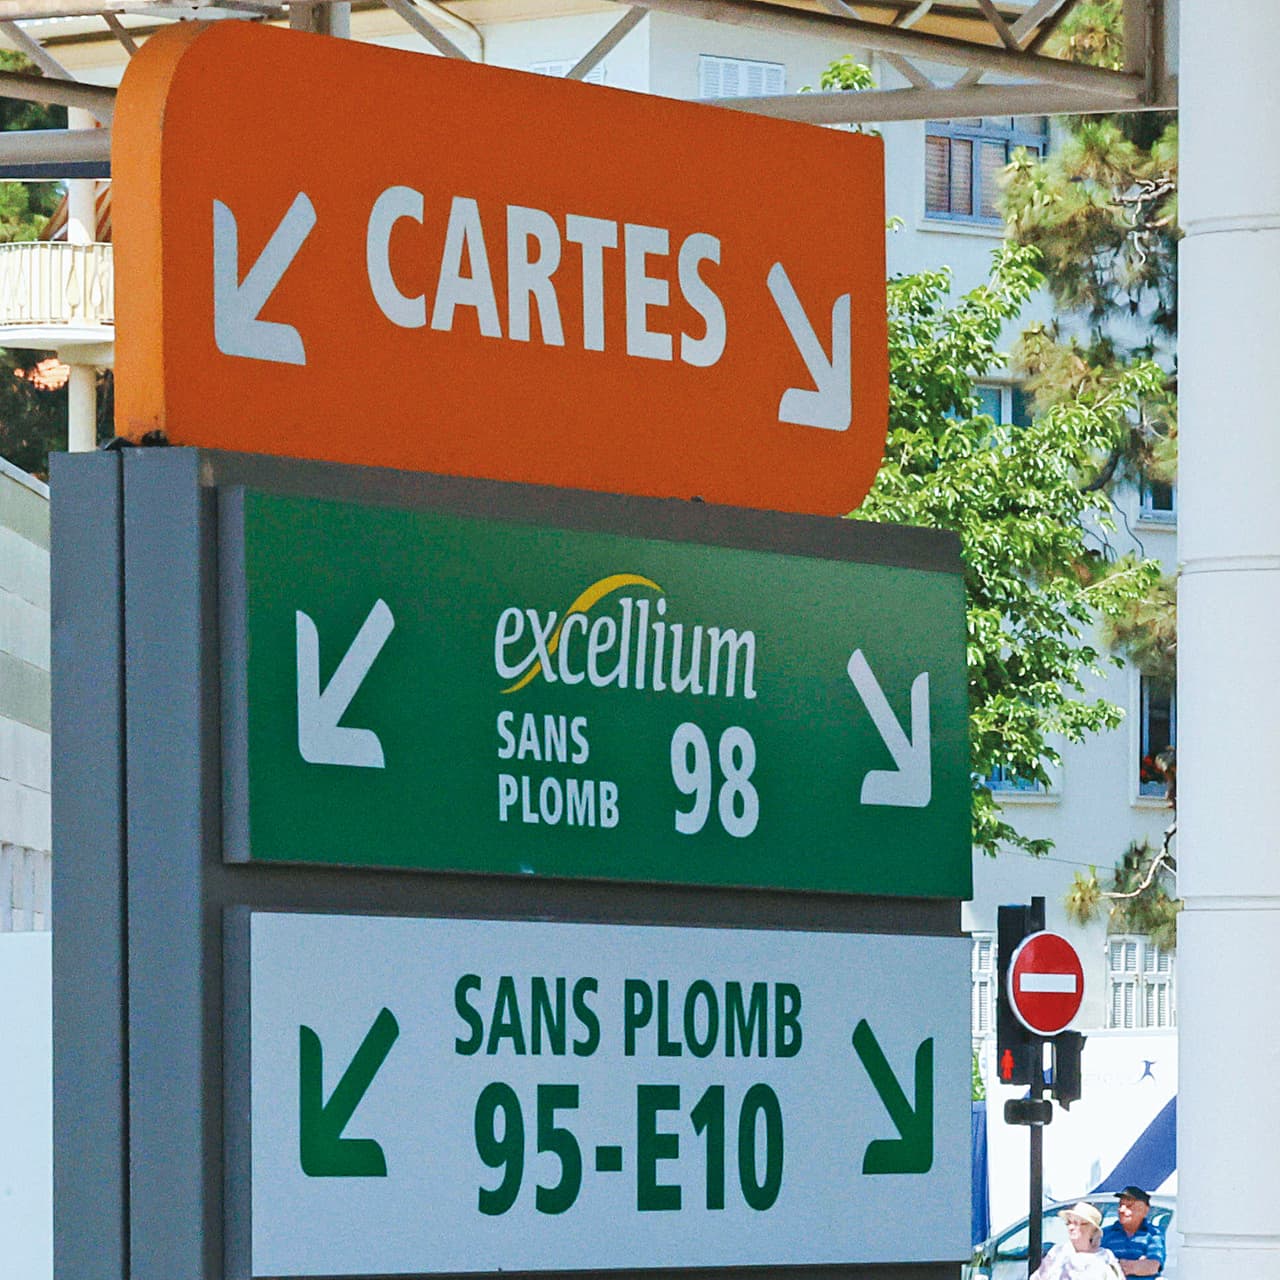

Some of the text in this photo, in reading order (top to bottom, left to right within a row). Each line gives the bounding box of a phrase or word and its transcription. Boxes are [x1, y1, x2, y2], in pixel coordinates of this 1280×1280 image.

[366, 185, 727, 367] CARTES
[494, 597, 758, 699] excellium
[497, 709, 589, 765] SANS
[669, 725, 760, 838] 98
[498, 774, 620, 830] PLOMB
[454, 974, 802, 1060] SANS PLOMB
[473, 1083, 785, 1216] 95-E10
